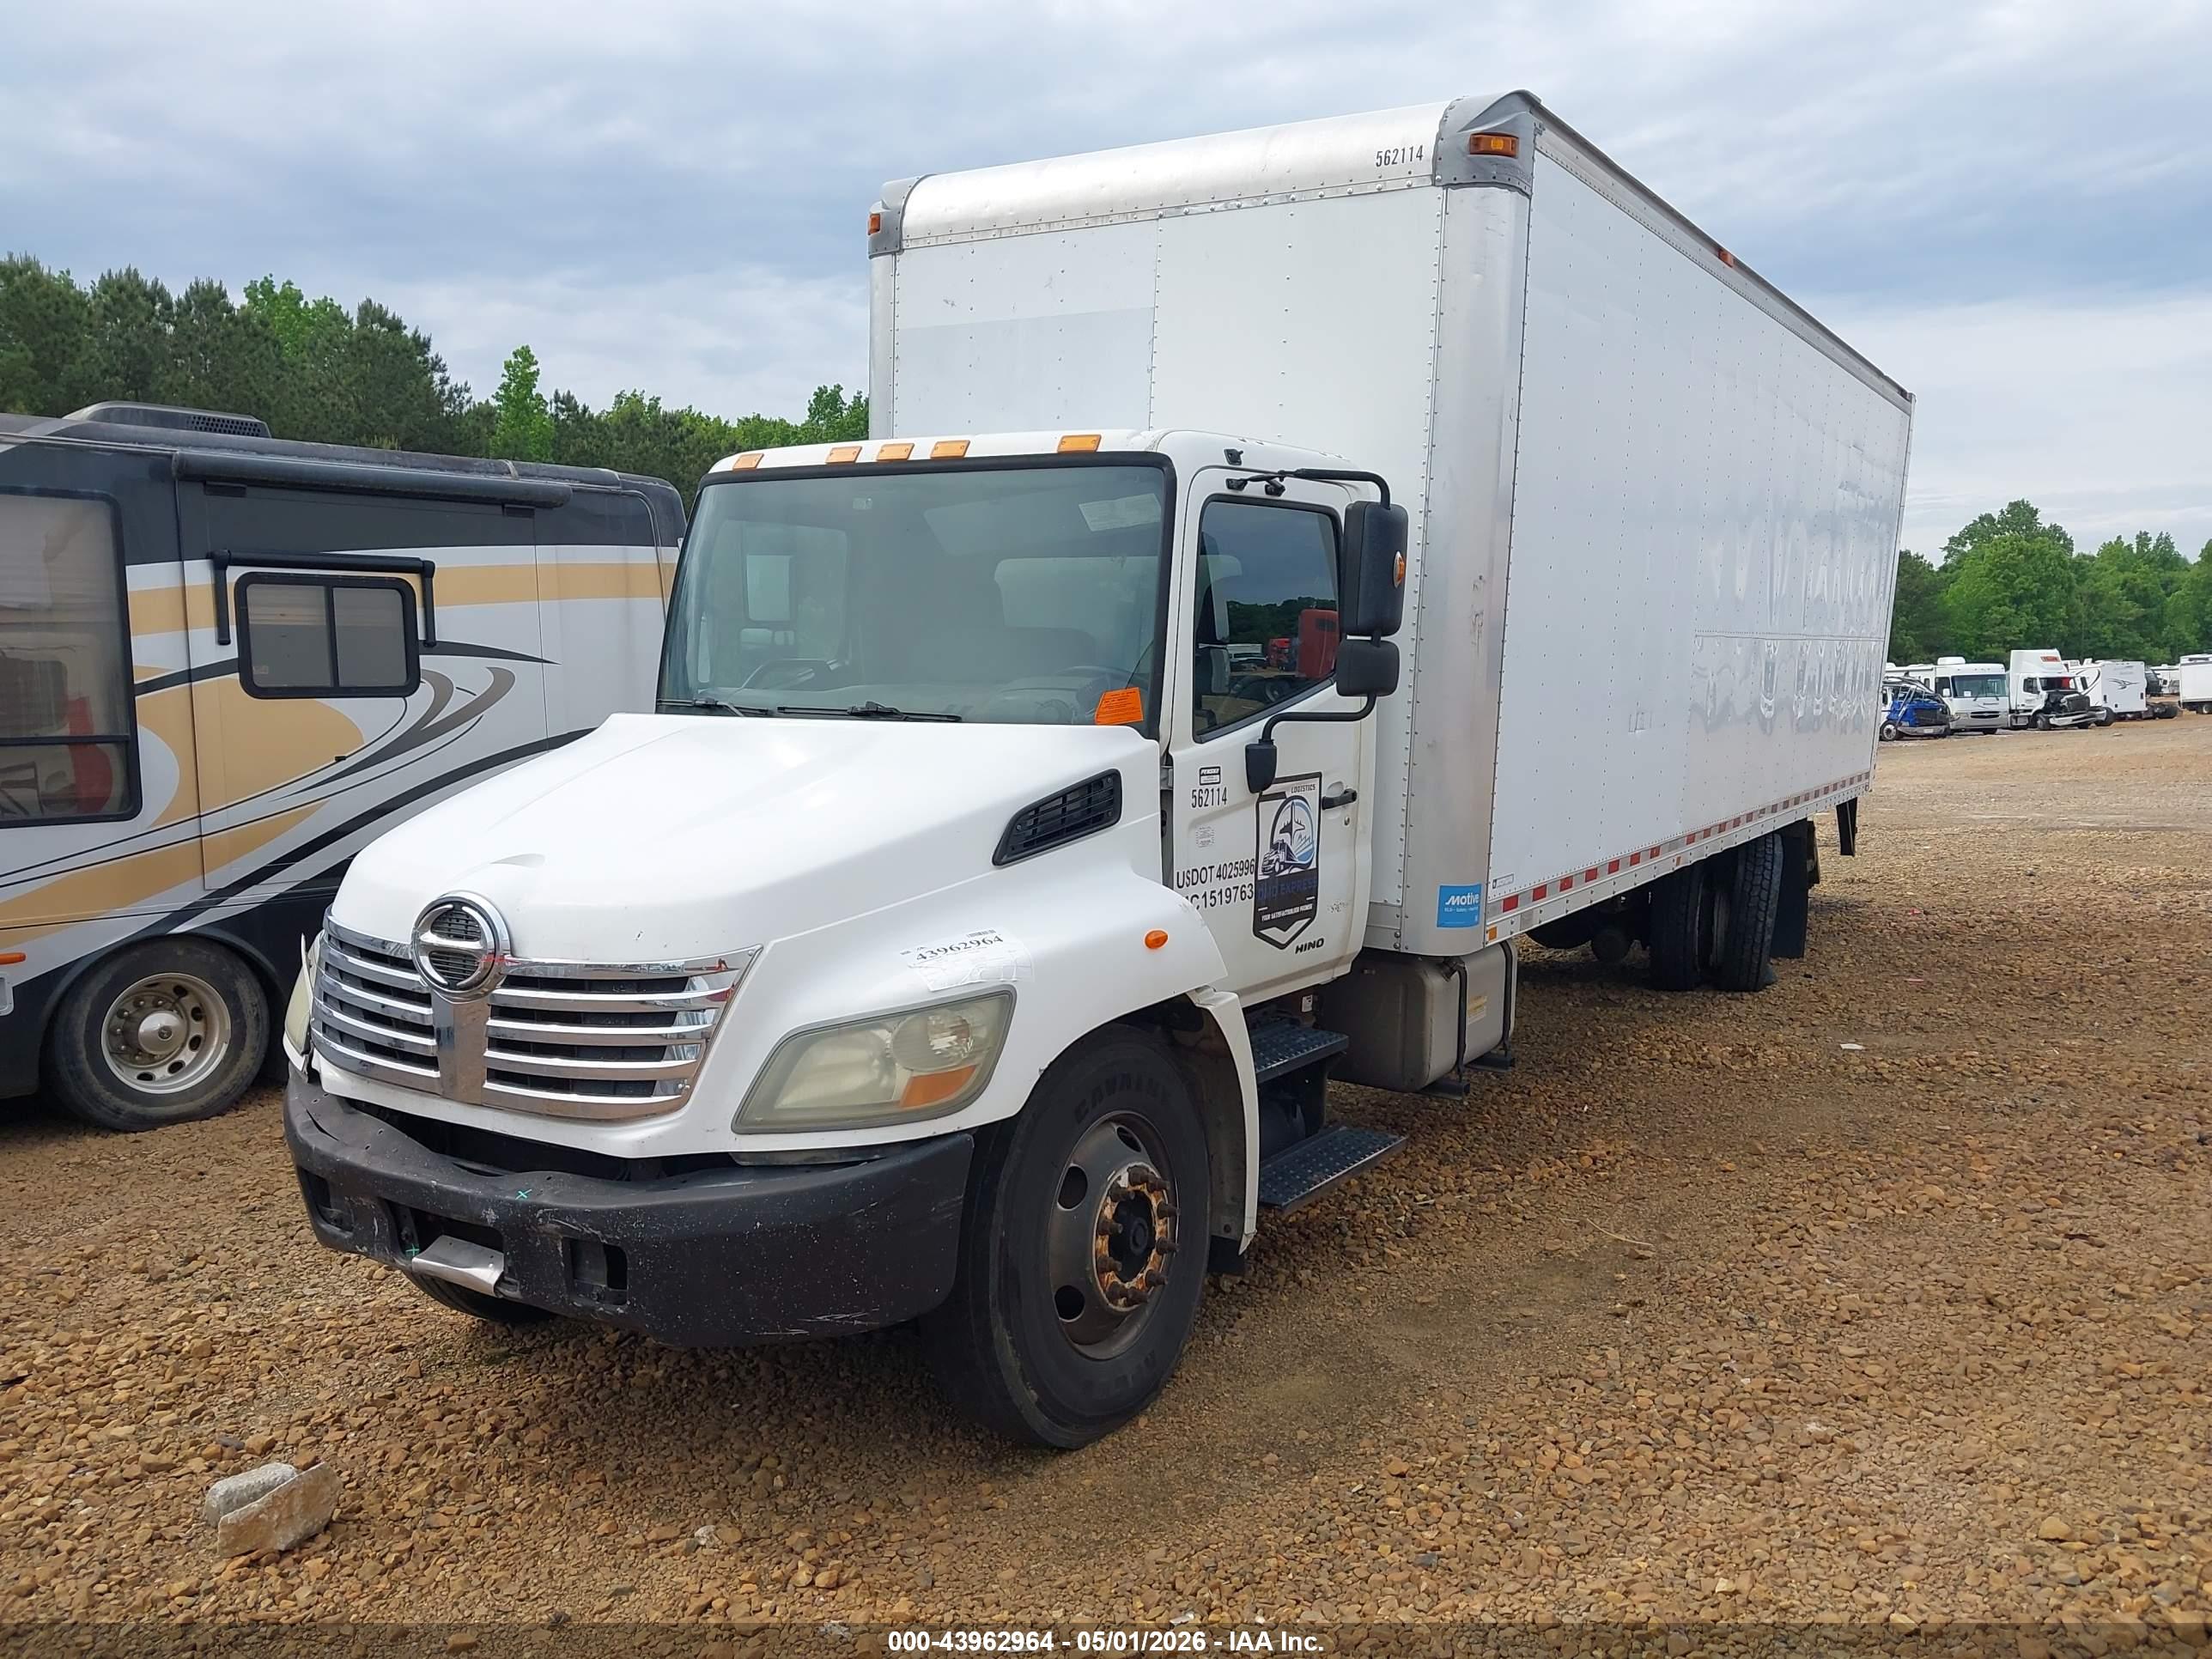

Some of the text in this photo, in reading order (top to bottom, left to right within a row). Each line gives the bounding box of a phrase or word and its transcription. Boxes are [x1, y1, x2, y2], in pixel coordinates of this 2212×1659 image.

[1376, 144, 1423, 167] 562114
[1191, 787, 1227, 808] 562114
[1291, 783, 1316, 793] LOGISTICS
[1176, 858, 1255, 889] USDOT 4025996
[916, 935, 1003, 961] 43962964
[1295, 938, 1325, 954] HINO
